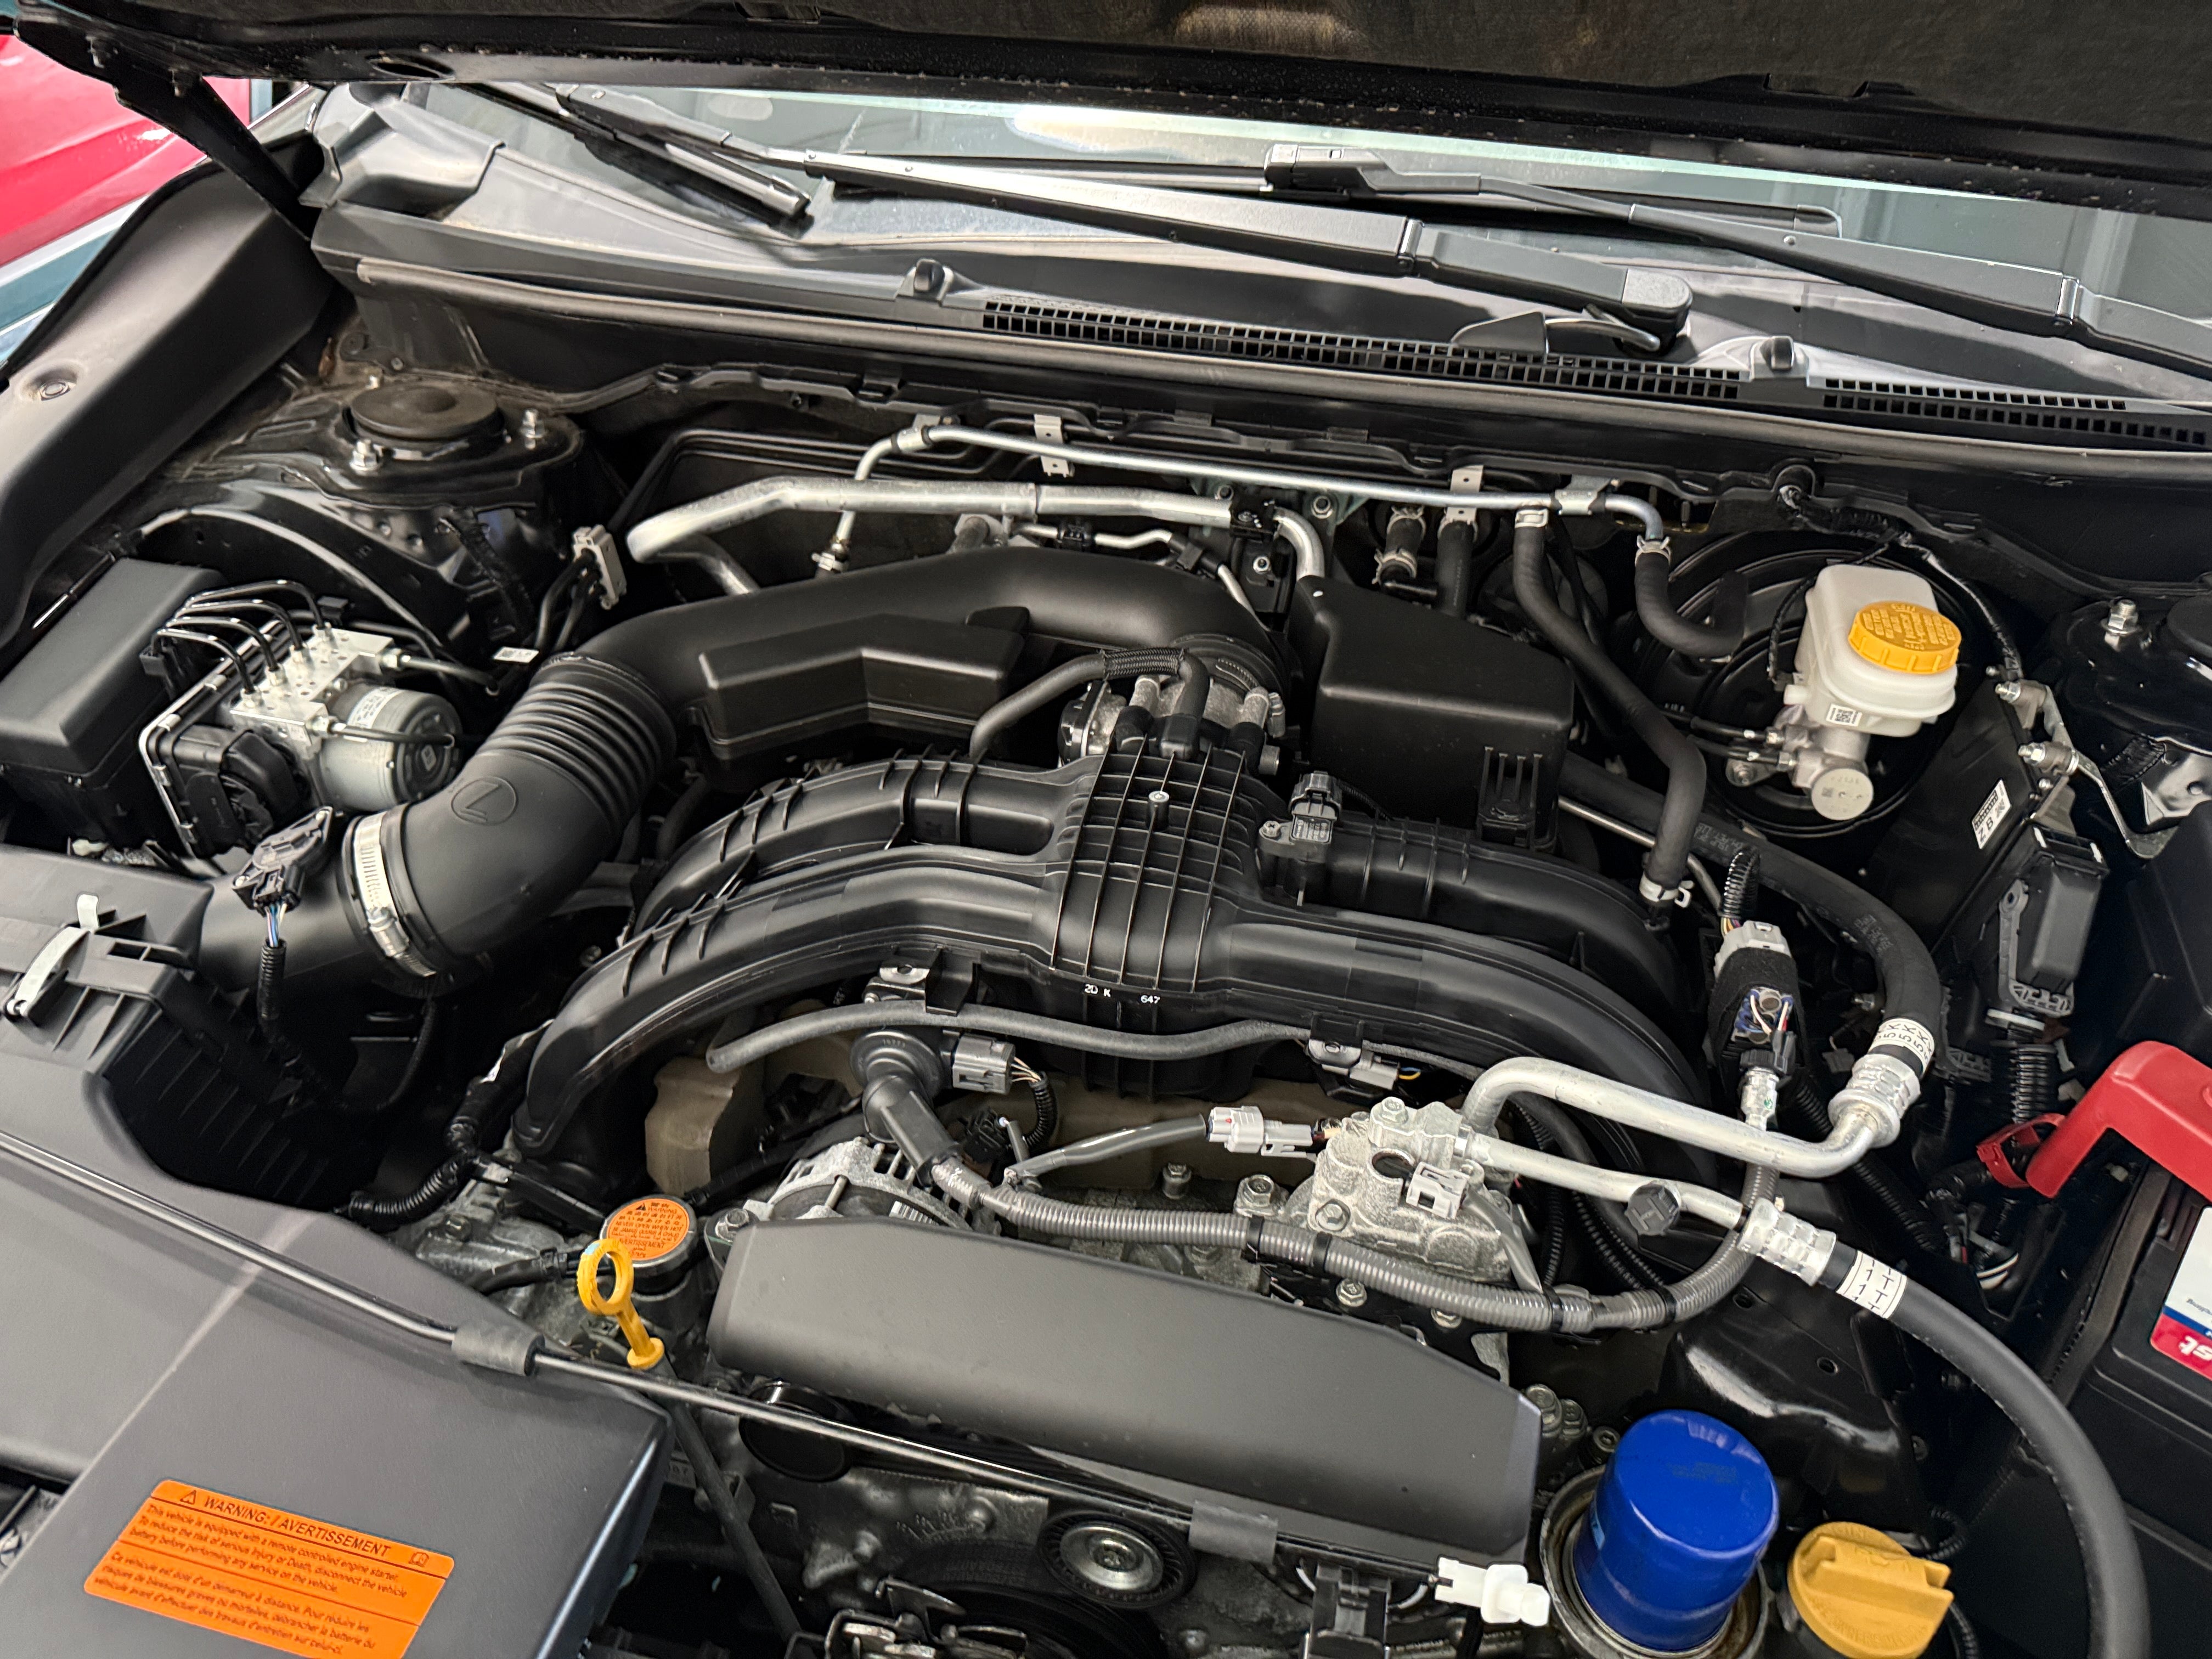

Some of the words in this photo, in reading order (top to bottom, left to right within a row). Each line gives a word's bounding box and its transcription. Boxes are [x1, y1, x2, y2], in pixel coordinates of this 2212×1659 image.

[1140, 995, 1160, 1005] 647
[205, 1497, 269, 1523] WARNING:
[279, 1520, 390, 1555] AVERTISSEMENT
[341, 1561, 369, 1573] engine
[315, 1567, 361, 1584] disconnect
[362, 1579, 376, 1589] the
[377, 1585, 407, 1598] vehicle
